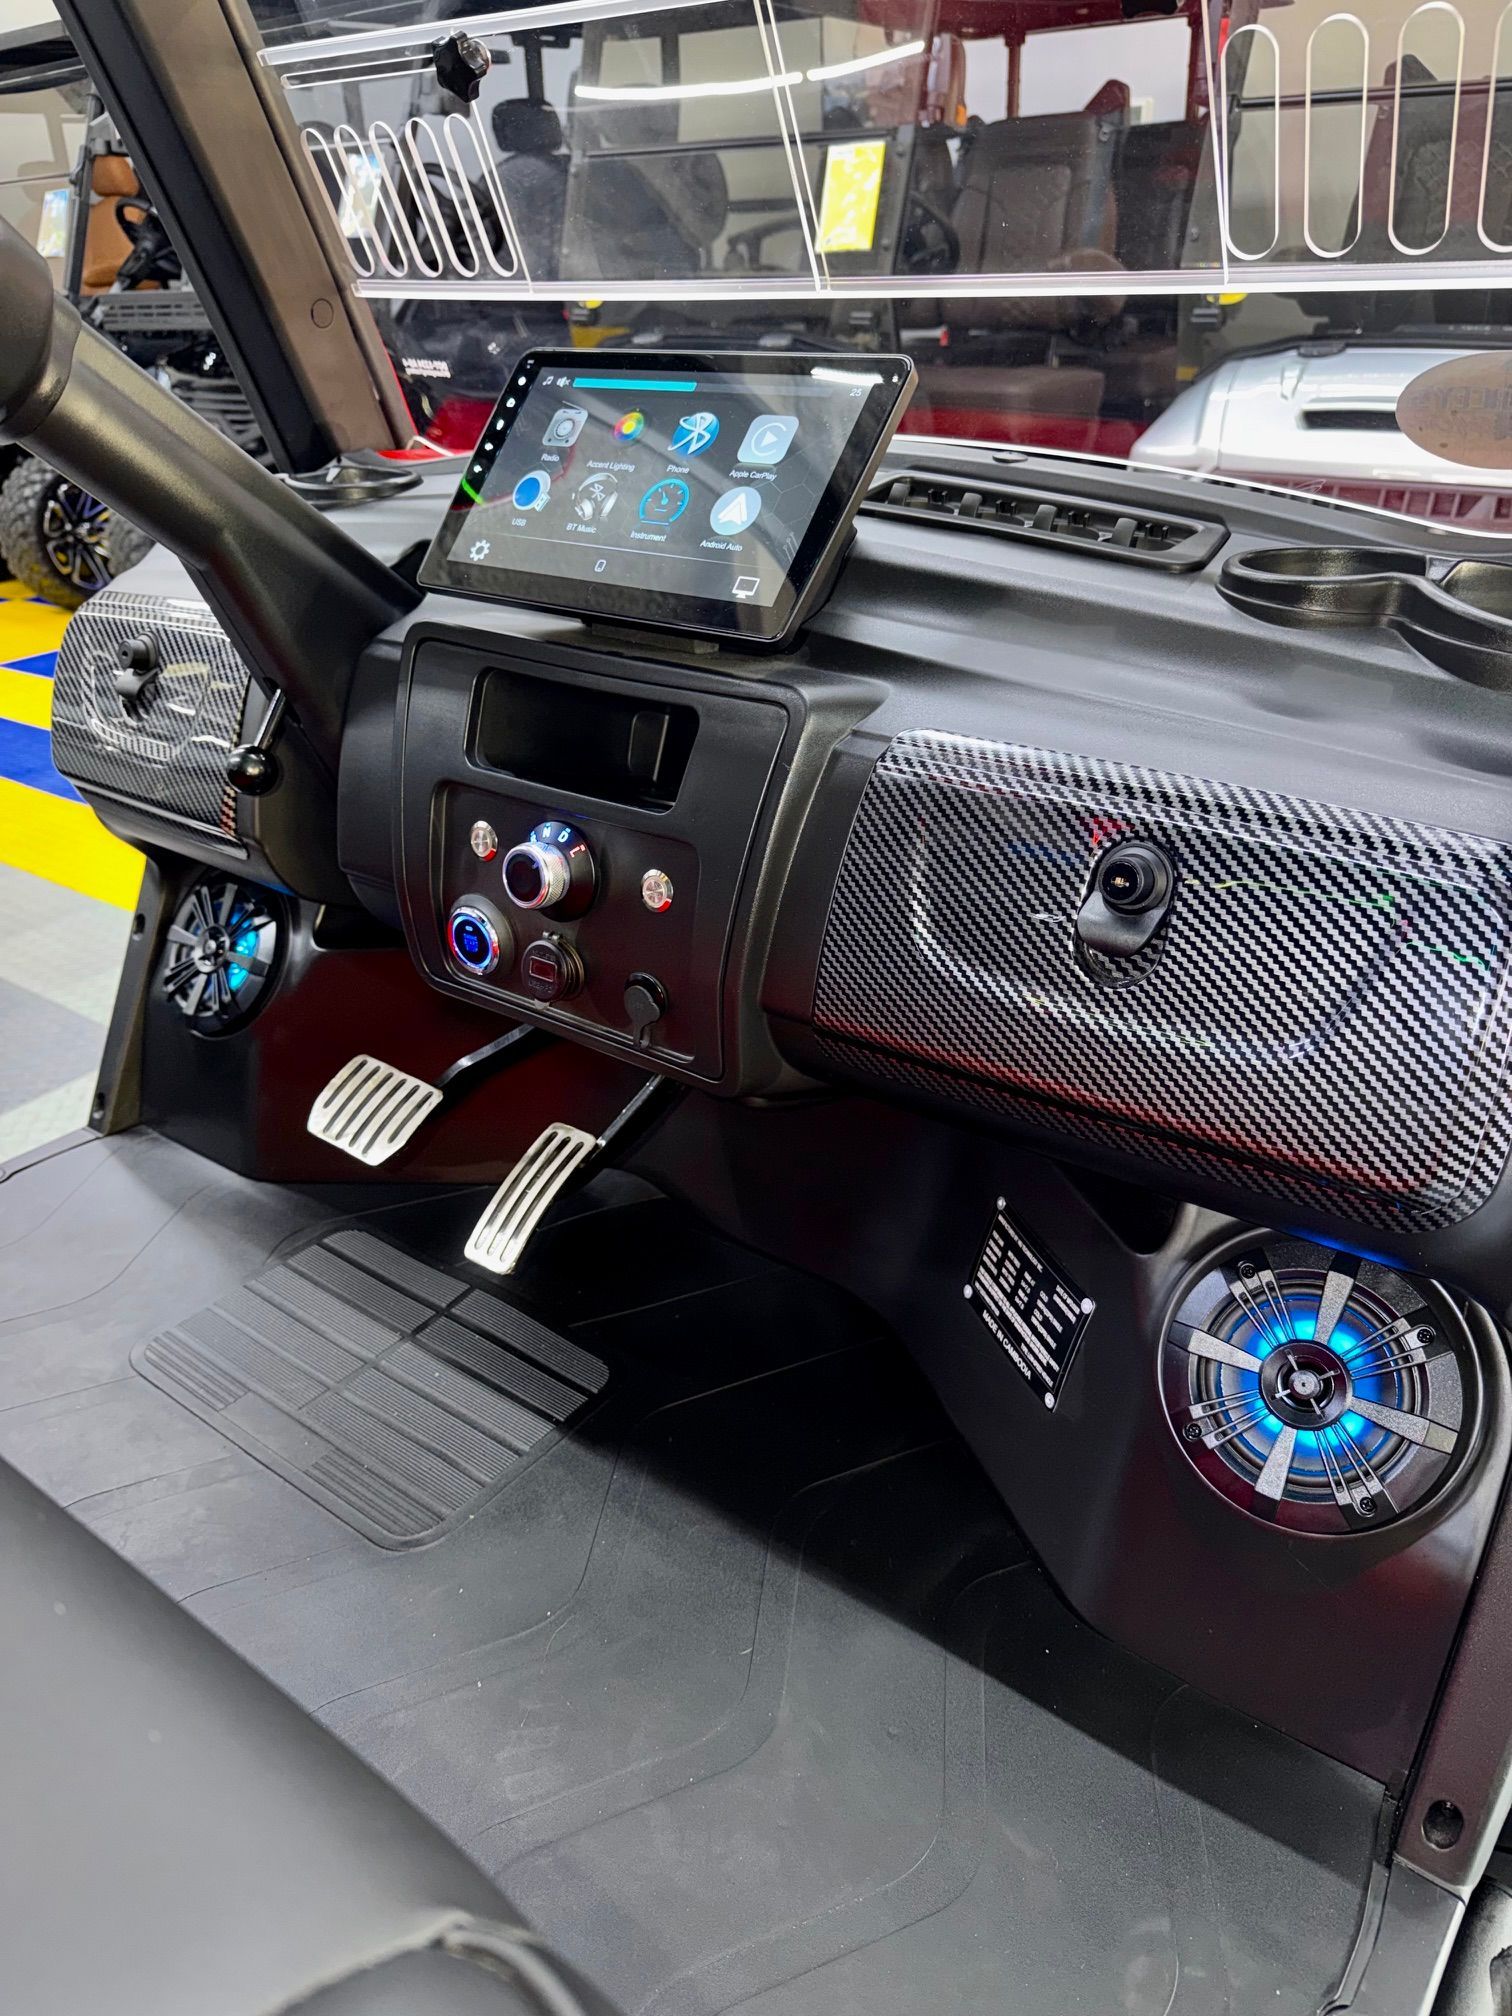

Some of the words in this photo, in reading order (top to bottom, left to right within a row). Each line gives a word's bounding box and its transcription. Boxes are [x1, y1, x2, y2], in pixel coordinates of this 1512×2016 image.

[850, 388, 862, 397] 25
[541, 453, 560, 462] Radio
[586, 460, 609, 470] Accent
[609, 462, 635, 472] Lighting
[666, 464, 690, 474] Phone
[729, 469, 749, 479] Apple
[749, 471, 777, 482] CarPlay
[511, 518, 527, 527] USB
[566, 523, 577, 531] BT
[577, 524, 597, 534] Music
[630, 530, 667, 542] Instrument
[700, 539, 725, 551] Android
[725, 542, 743, 552] Auto
[557, 830, 569, 842] D
[982, 1309, 998, 1334] MADE
[1002, 1337, 1032, 1380] CAMBODIA
